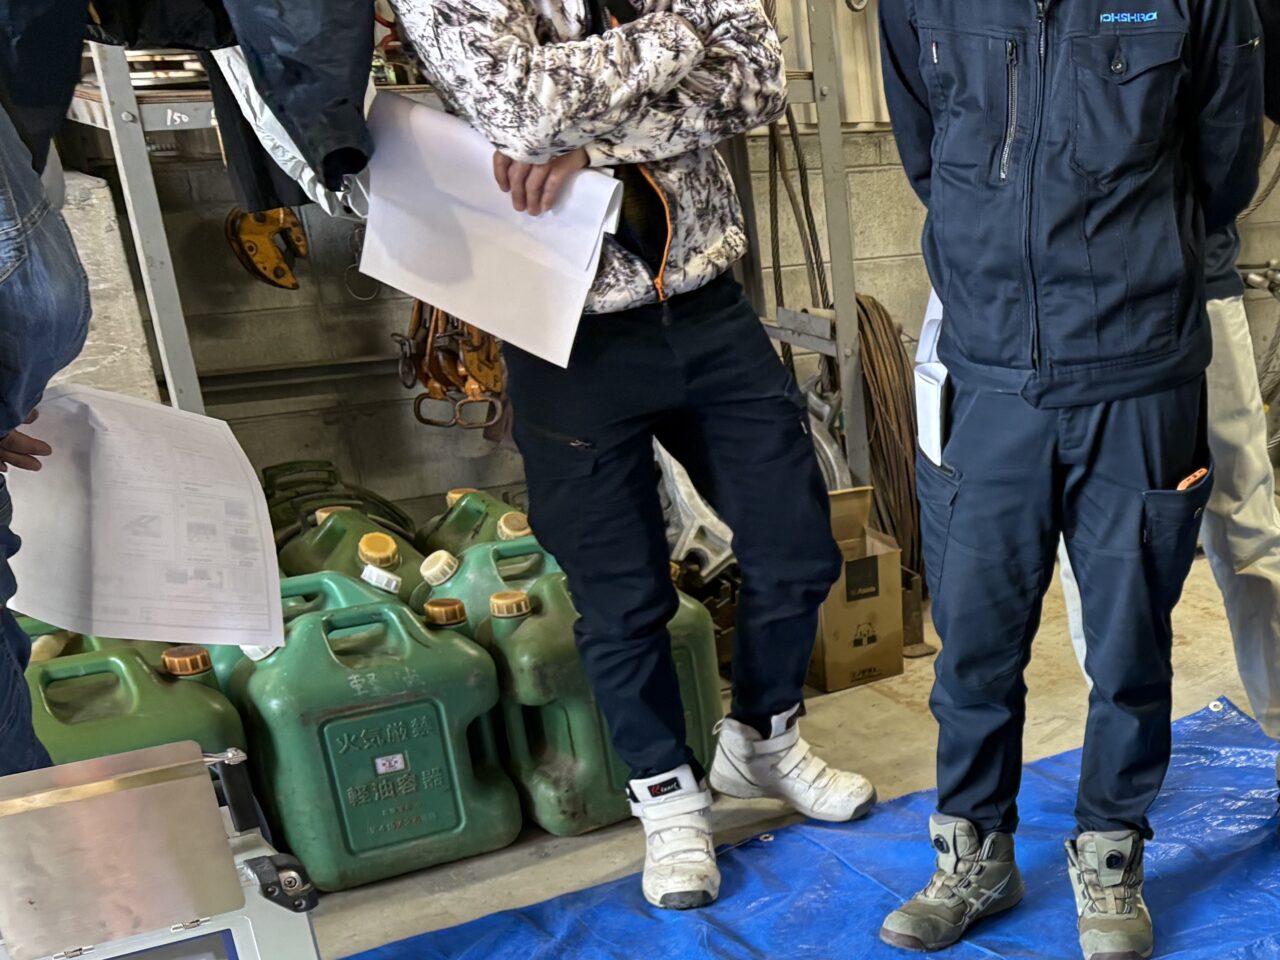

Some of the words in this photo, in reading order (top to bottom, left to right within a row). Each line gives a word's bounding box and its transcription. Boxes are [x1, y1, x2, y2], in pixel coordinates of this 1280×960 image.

[166, 108, 190, 126] 150
[335, 715, 433, 754] 火気厳禁
[346, 767, 445, 807] 軽油容器
